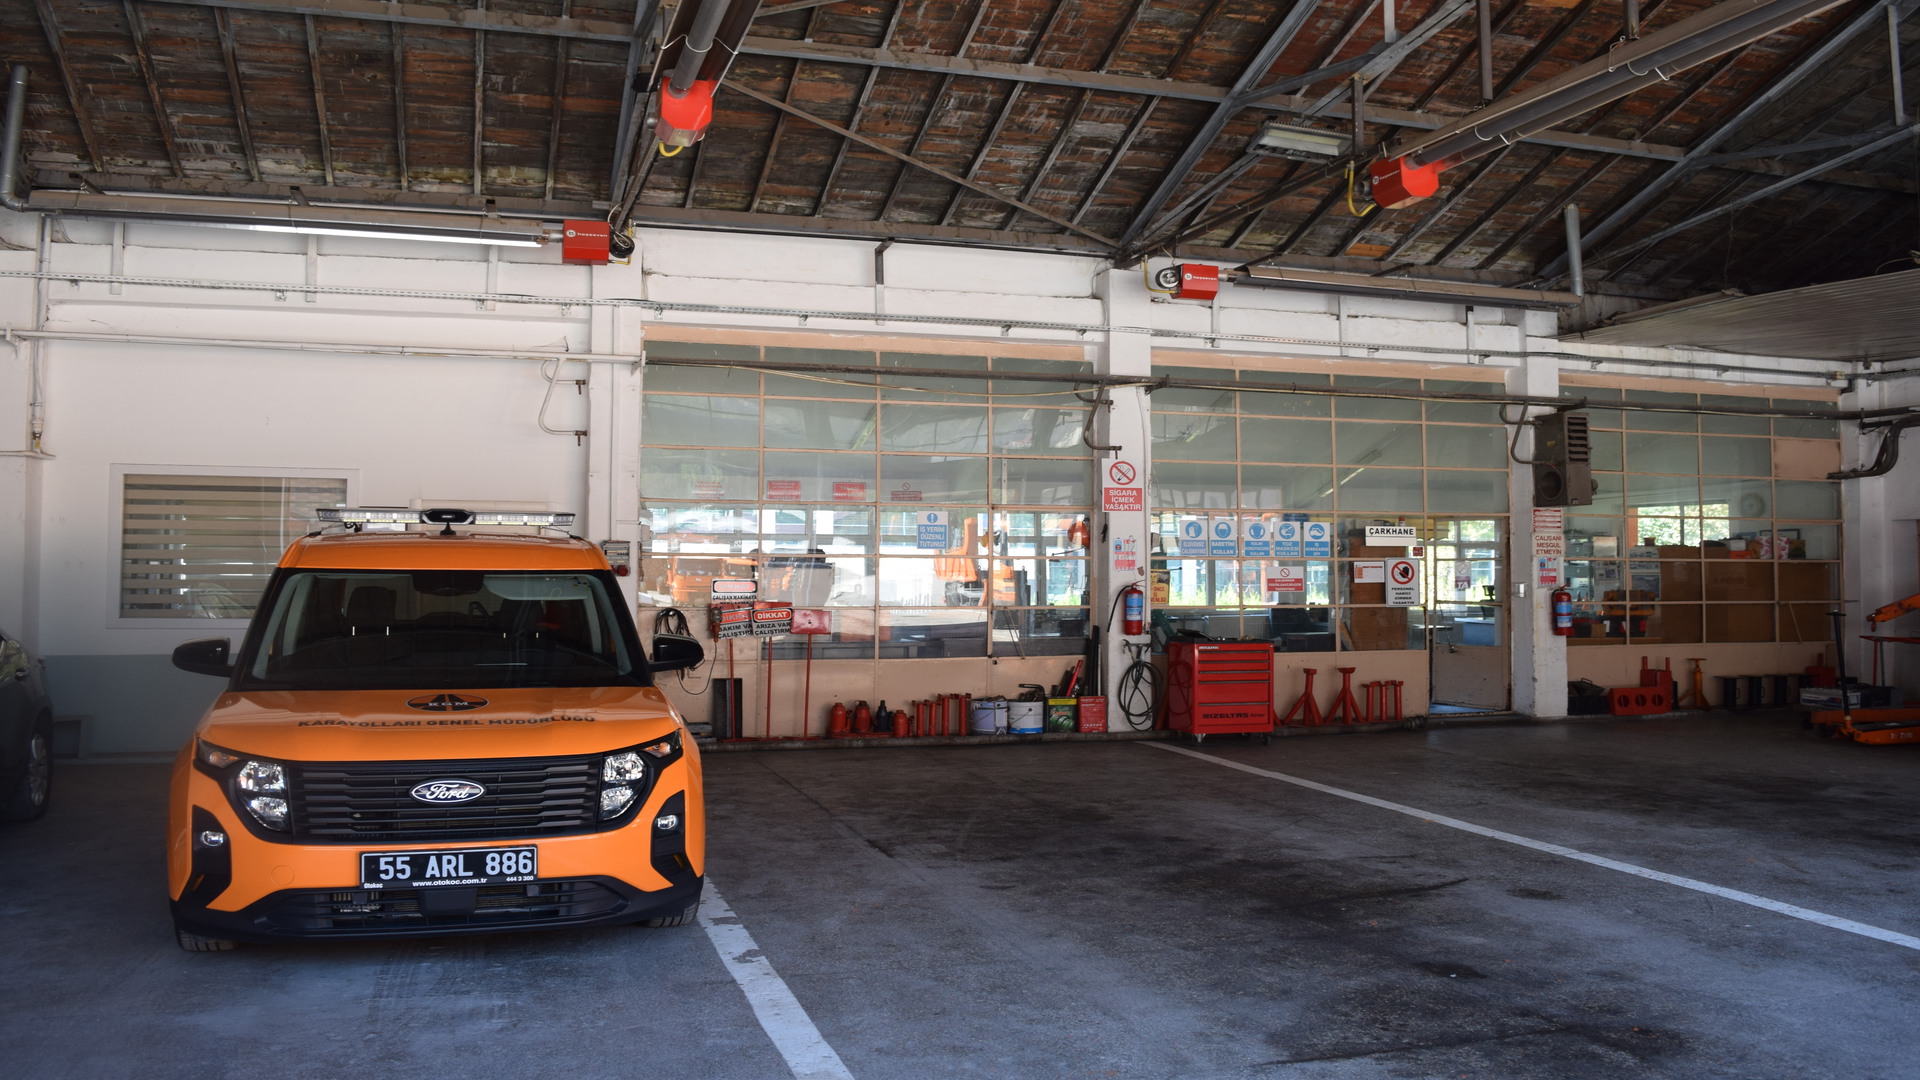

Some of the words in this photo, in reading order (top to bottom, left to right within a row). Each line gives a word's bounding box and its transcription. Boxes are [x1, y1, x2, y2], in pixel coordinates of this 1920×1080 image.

[1111, 496, 1135, 504] İÇMEK
[1105, 503, 1141, 511] YASAKTIR
[920, 532, 944, 540] DÜZENLİ
[1369, 528, 1414, 536] ÇARKHANE
[298, 719, 422, 728] KARAYOLLARI
[488, 715, 596, 725] MÜDÜRLÜĞÜ
[426, 784, 469, 800] Ford
[379, 856, 411, 880] 55
[425, 854, 473, 878] ARL
[485, 851, 532, 875] 886
[412, 878, 488, 887] www.otokoc.com.tr
